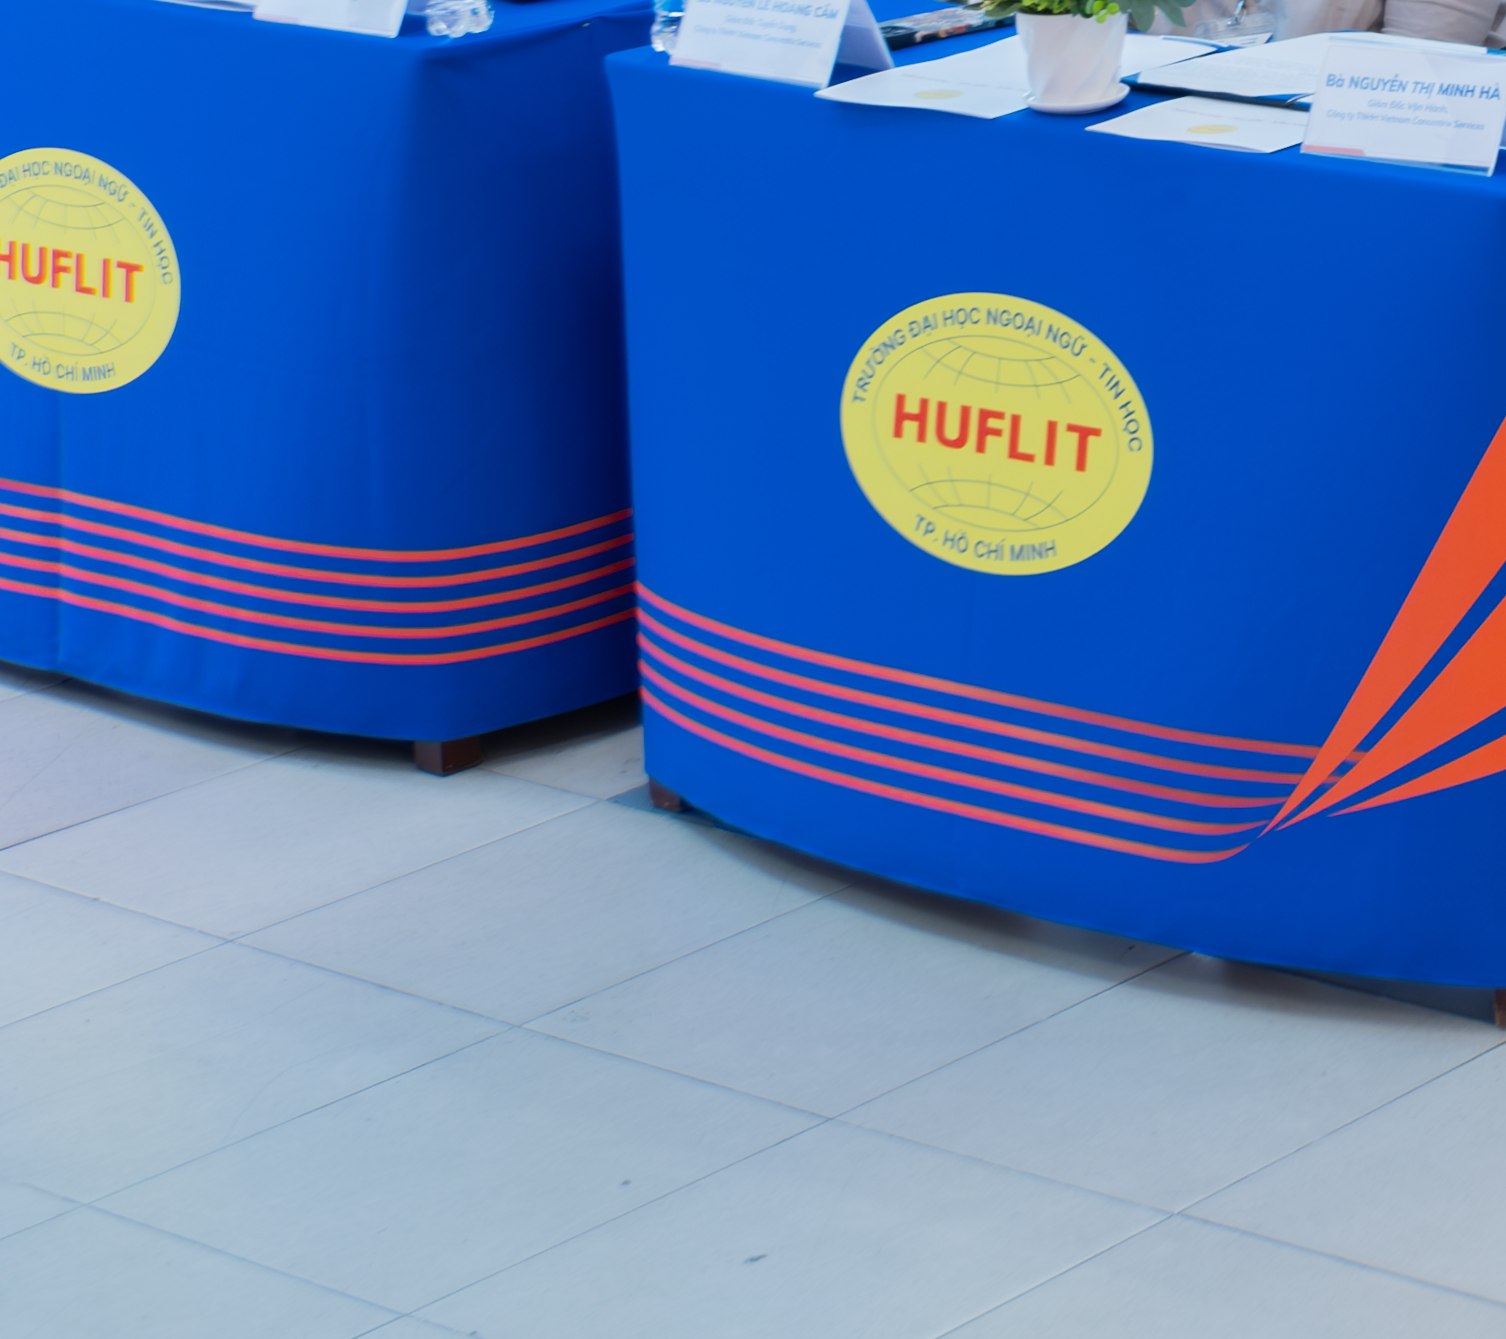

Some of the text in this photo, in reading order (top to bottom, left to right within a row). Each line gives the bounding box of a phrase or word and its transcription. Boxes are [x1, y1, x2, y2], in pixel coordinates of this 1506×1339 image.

[1325, 73, 1475, 99] Bà NGUYỄN THỊ MINH
[0, 239, 145, 304] HUFLIT
[893, 393, 1102, 472] HUFLIT
